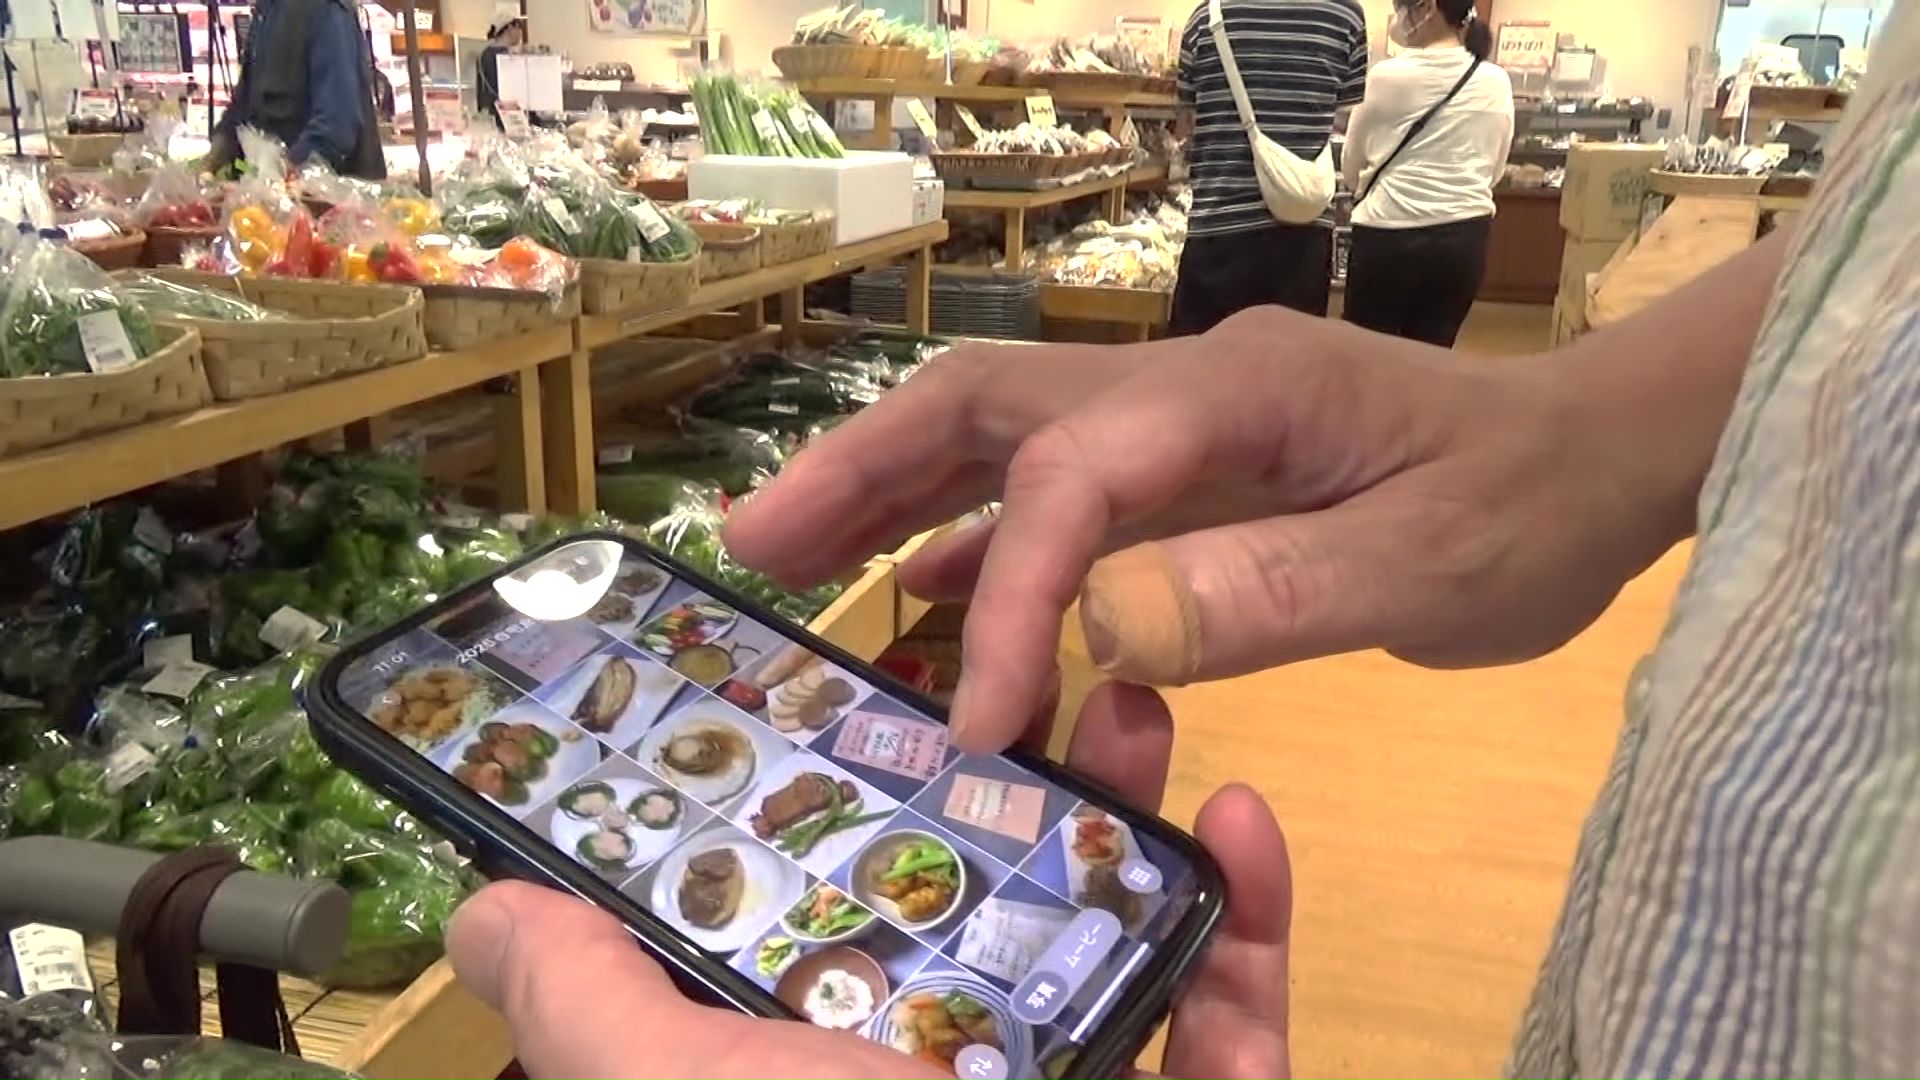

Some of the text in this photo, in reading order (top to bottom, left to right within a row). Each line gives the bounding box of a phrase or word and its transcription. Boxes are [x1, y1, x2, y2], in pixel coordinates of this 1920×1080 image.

[1063, 922, 1102, 969] ムービー
[1025, 980, 1058, 1009] 写真
